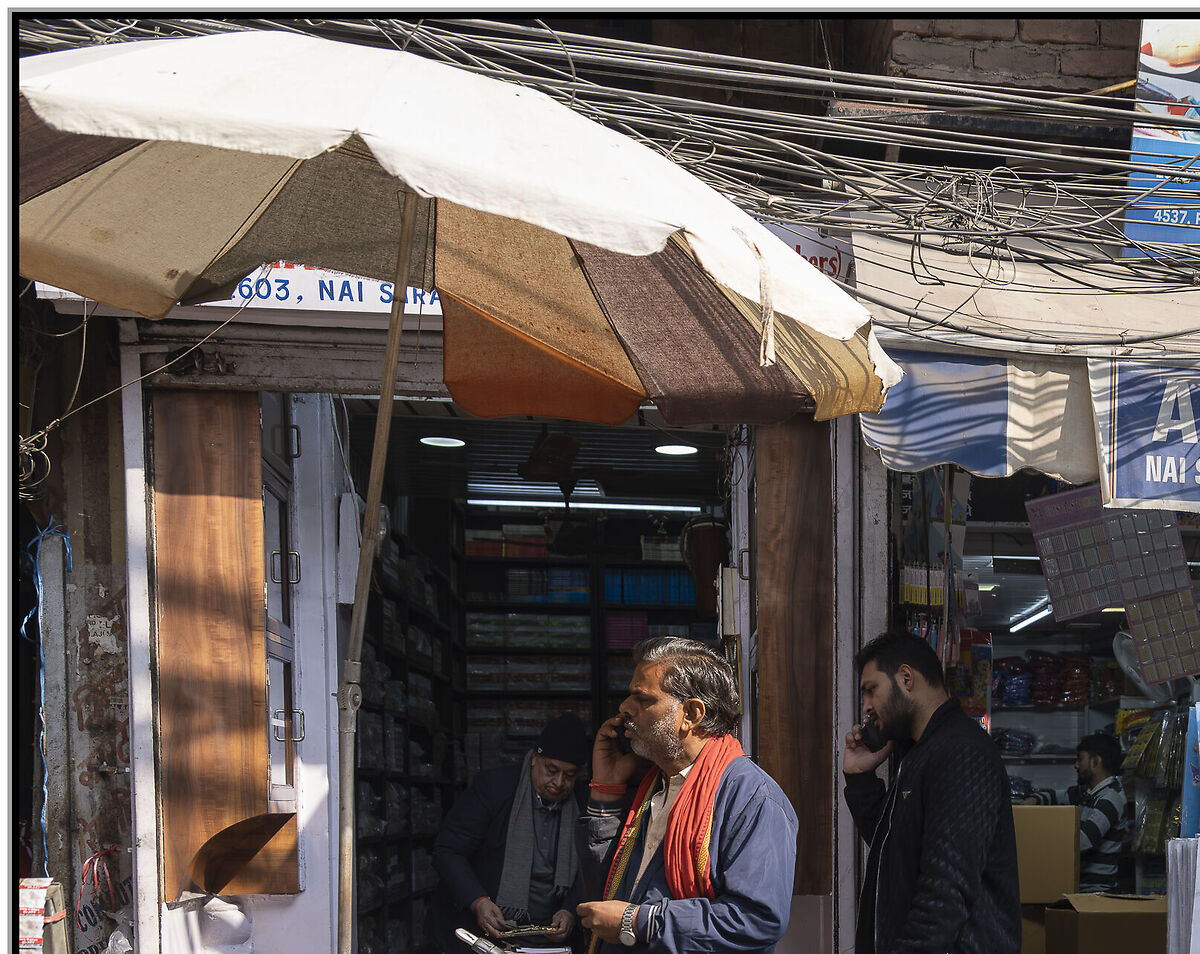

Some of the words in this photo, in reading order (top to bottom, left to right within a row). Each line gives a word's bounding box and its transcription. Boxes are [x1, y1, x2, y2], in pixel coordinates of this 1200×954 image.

[318, 279, 363, 302] NAI
[1152, 379, 1198, 444] A
[1144, 458, 1186, 485] NAI
